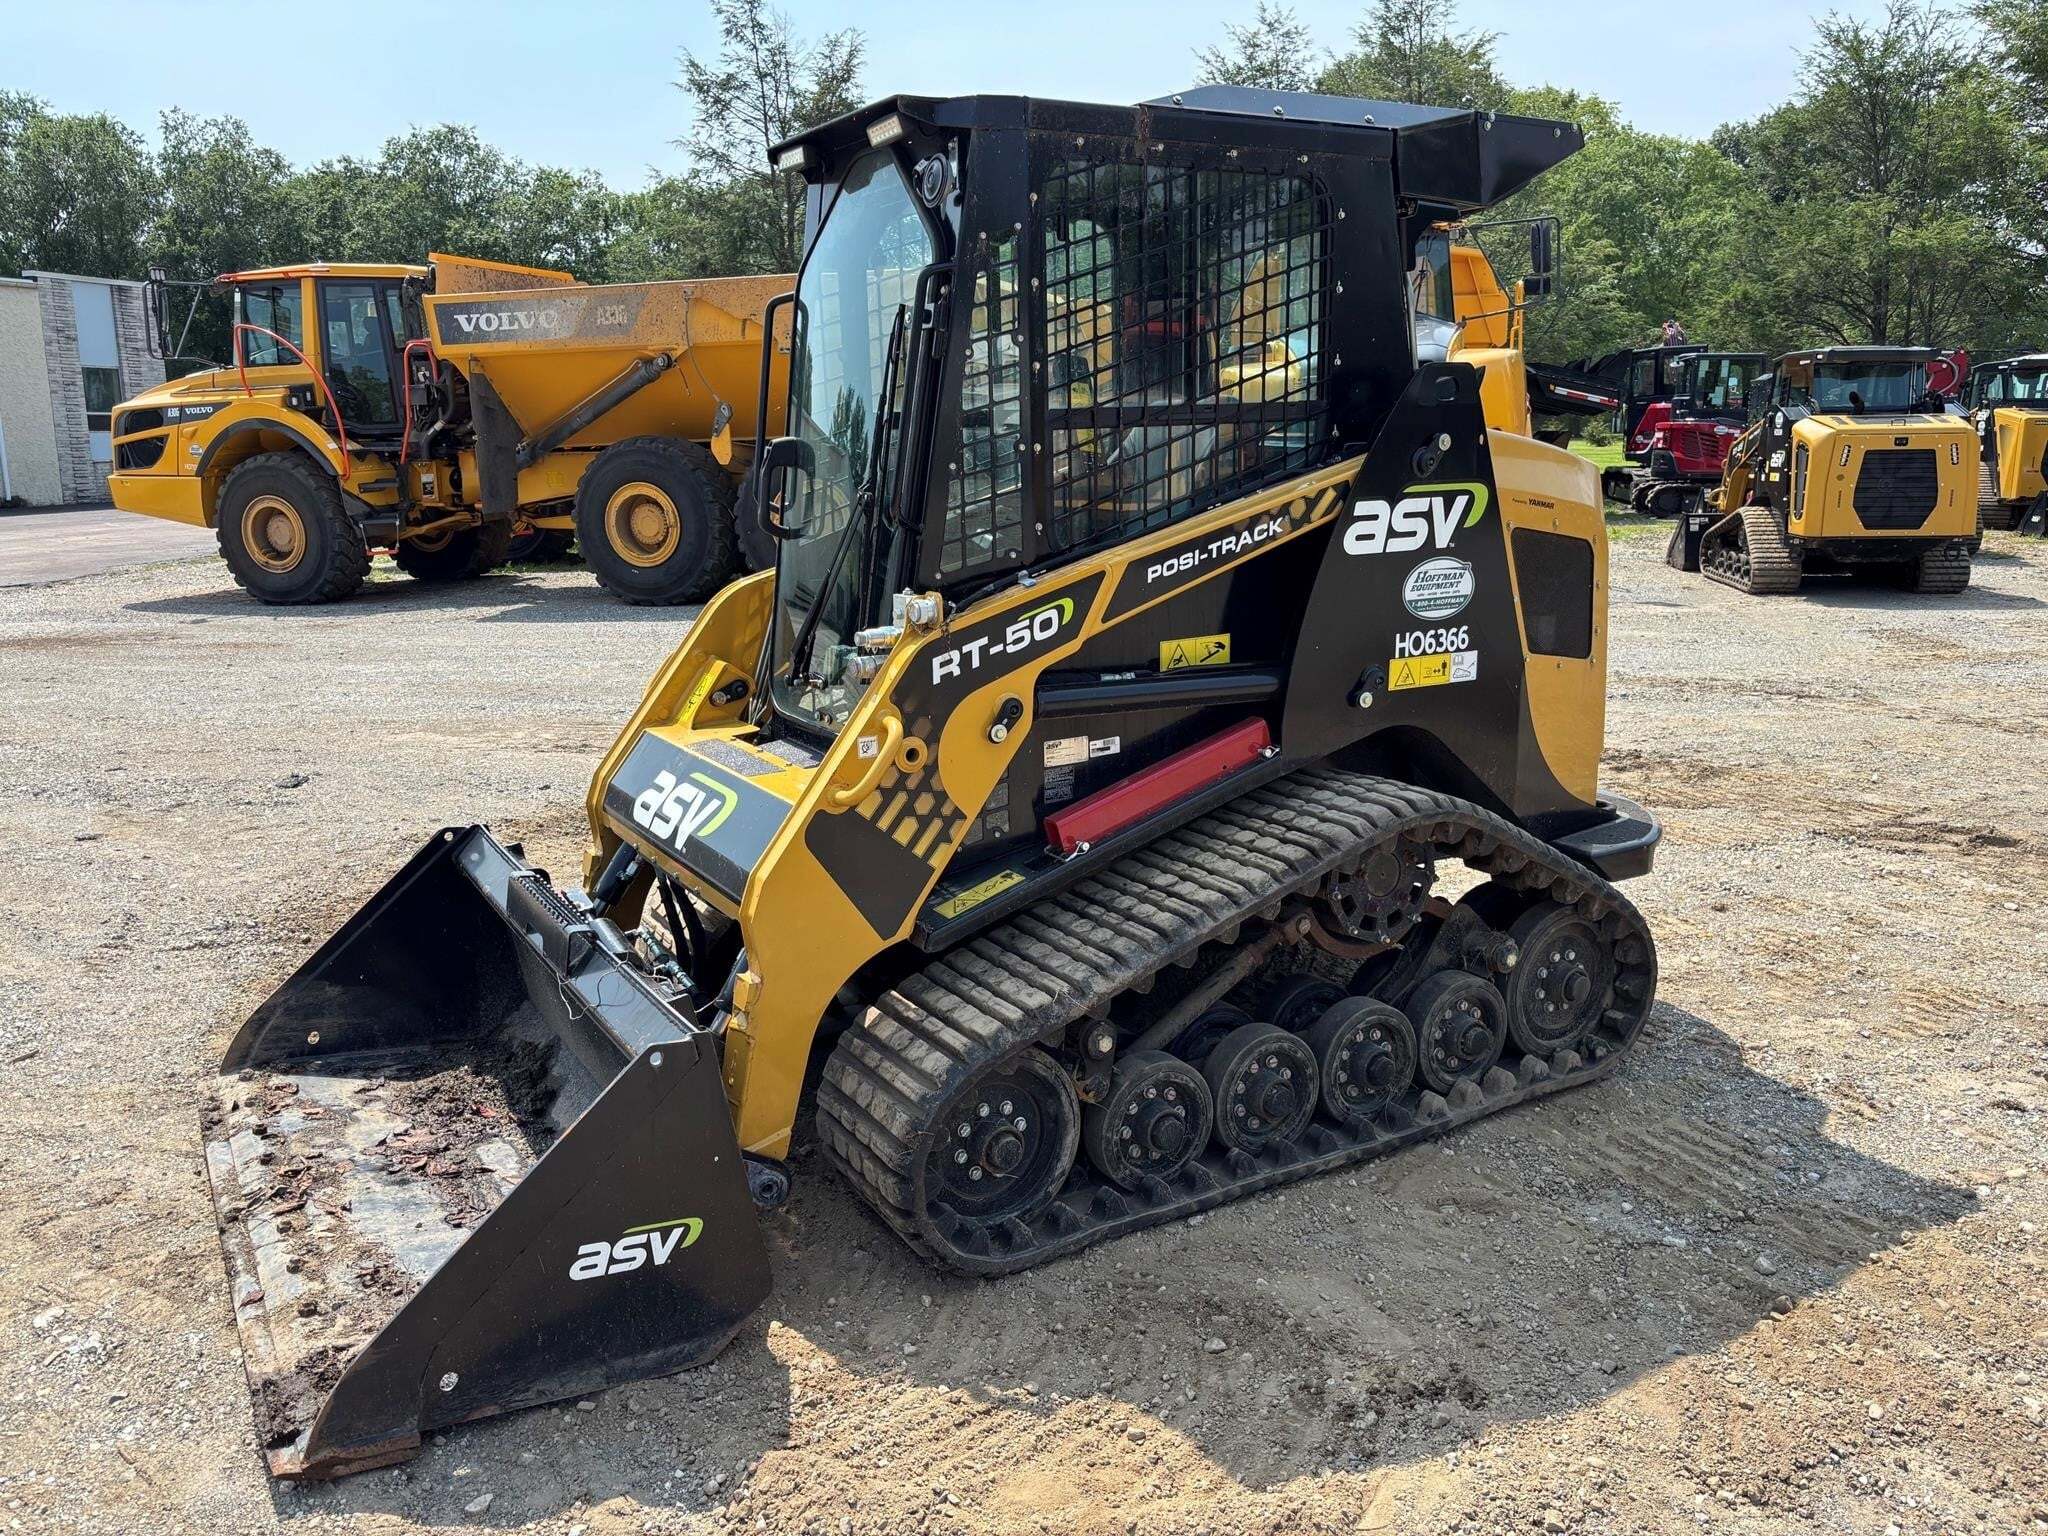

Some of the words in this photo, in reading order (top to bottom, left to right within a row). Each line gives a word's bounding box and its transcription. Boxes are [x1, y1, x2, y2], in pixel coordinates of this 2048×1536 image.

[454, 309, 559, 332] VOLVO
[184, 406, 214, 415] VOLVO
[1343, 495, 1470, 555] asv
[1147, 516, 1284, 584] POSI-TRACK
[1410, 580, 1462, 593] EQUIPMENT
[1413, 570, 1466, 584] HOFFMAN
[932, 608, 1060, 686] RT-50
[1395, 625, 1469, 659] HO6366
[633, 769, 722, 852] asv
[569, 1226, 685, 1281] asv
